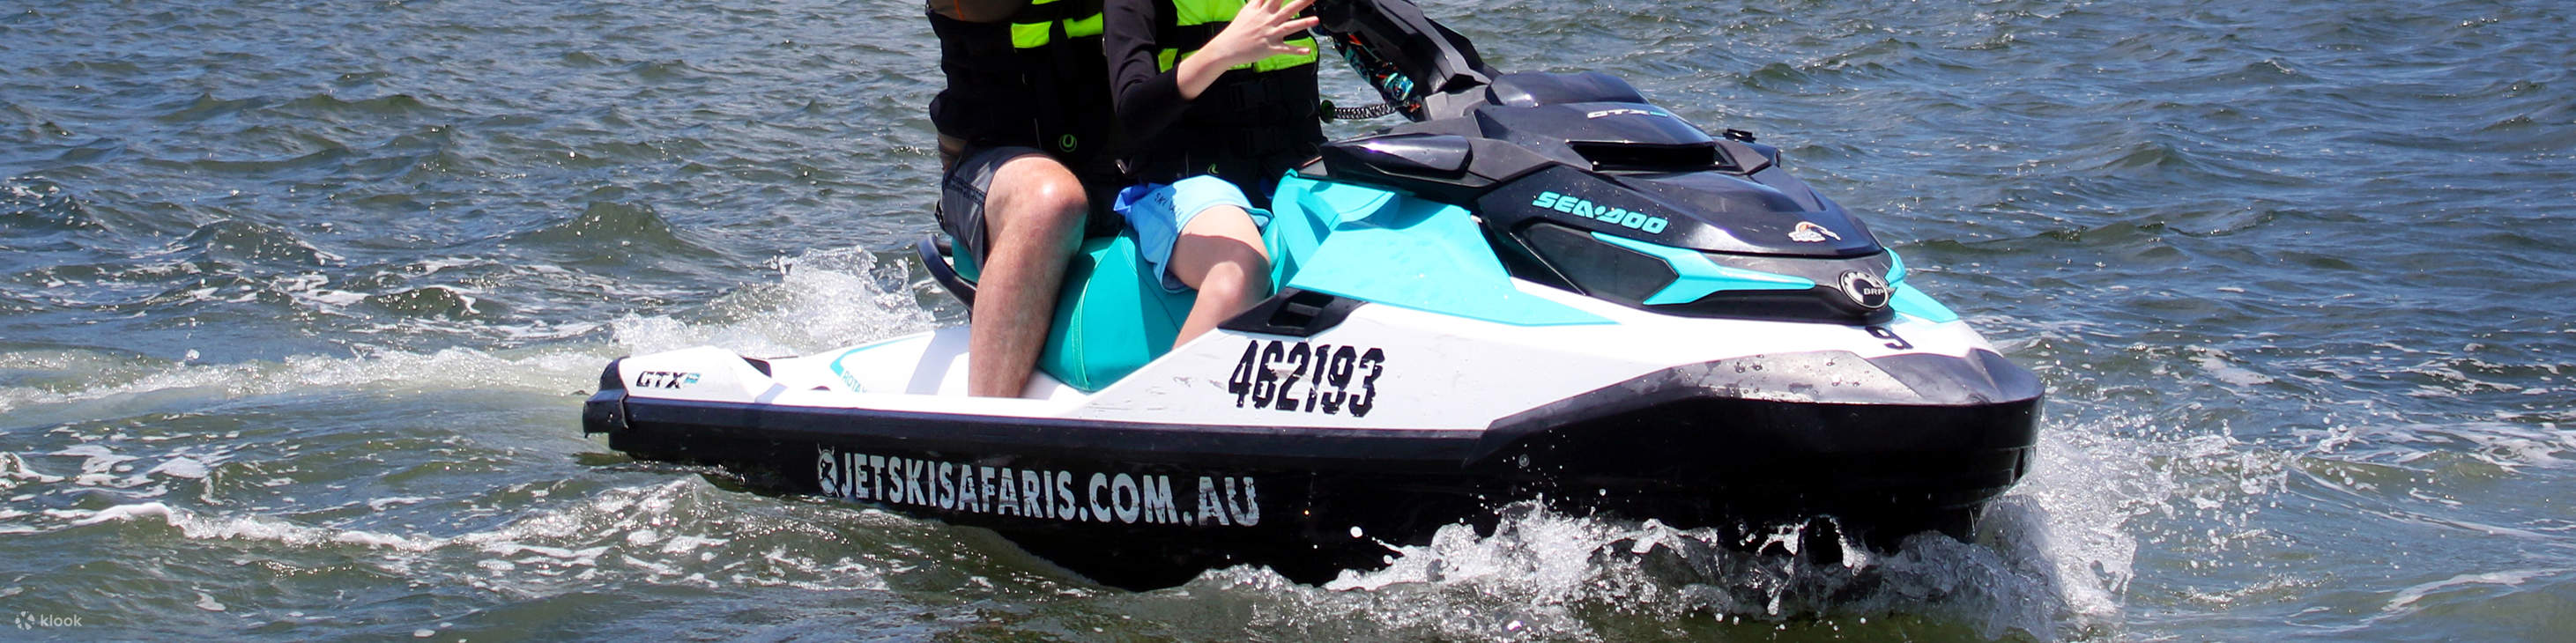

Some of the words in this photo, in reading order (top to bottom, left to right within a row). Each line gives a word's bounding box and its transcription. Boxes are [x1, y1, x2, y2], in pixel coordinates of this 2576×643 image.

[635, 370, 687, 388] GTX
[1228, 339, 1385, 418] 462193
[840, 452, 1259, 527] JETSKISAFARIS.COM.AU
